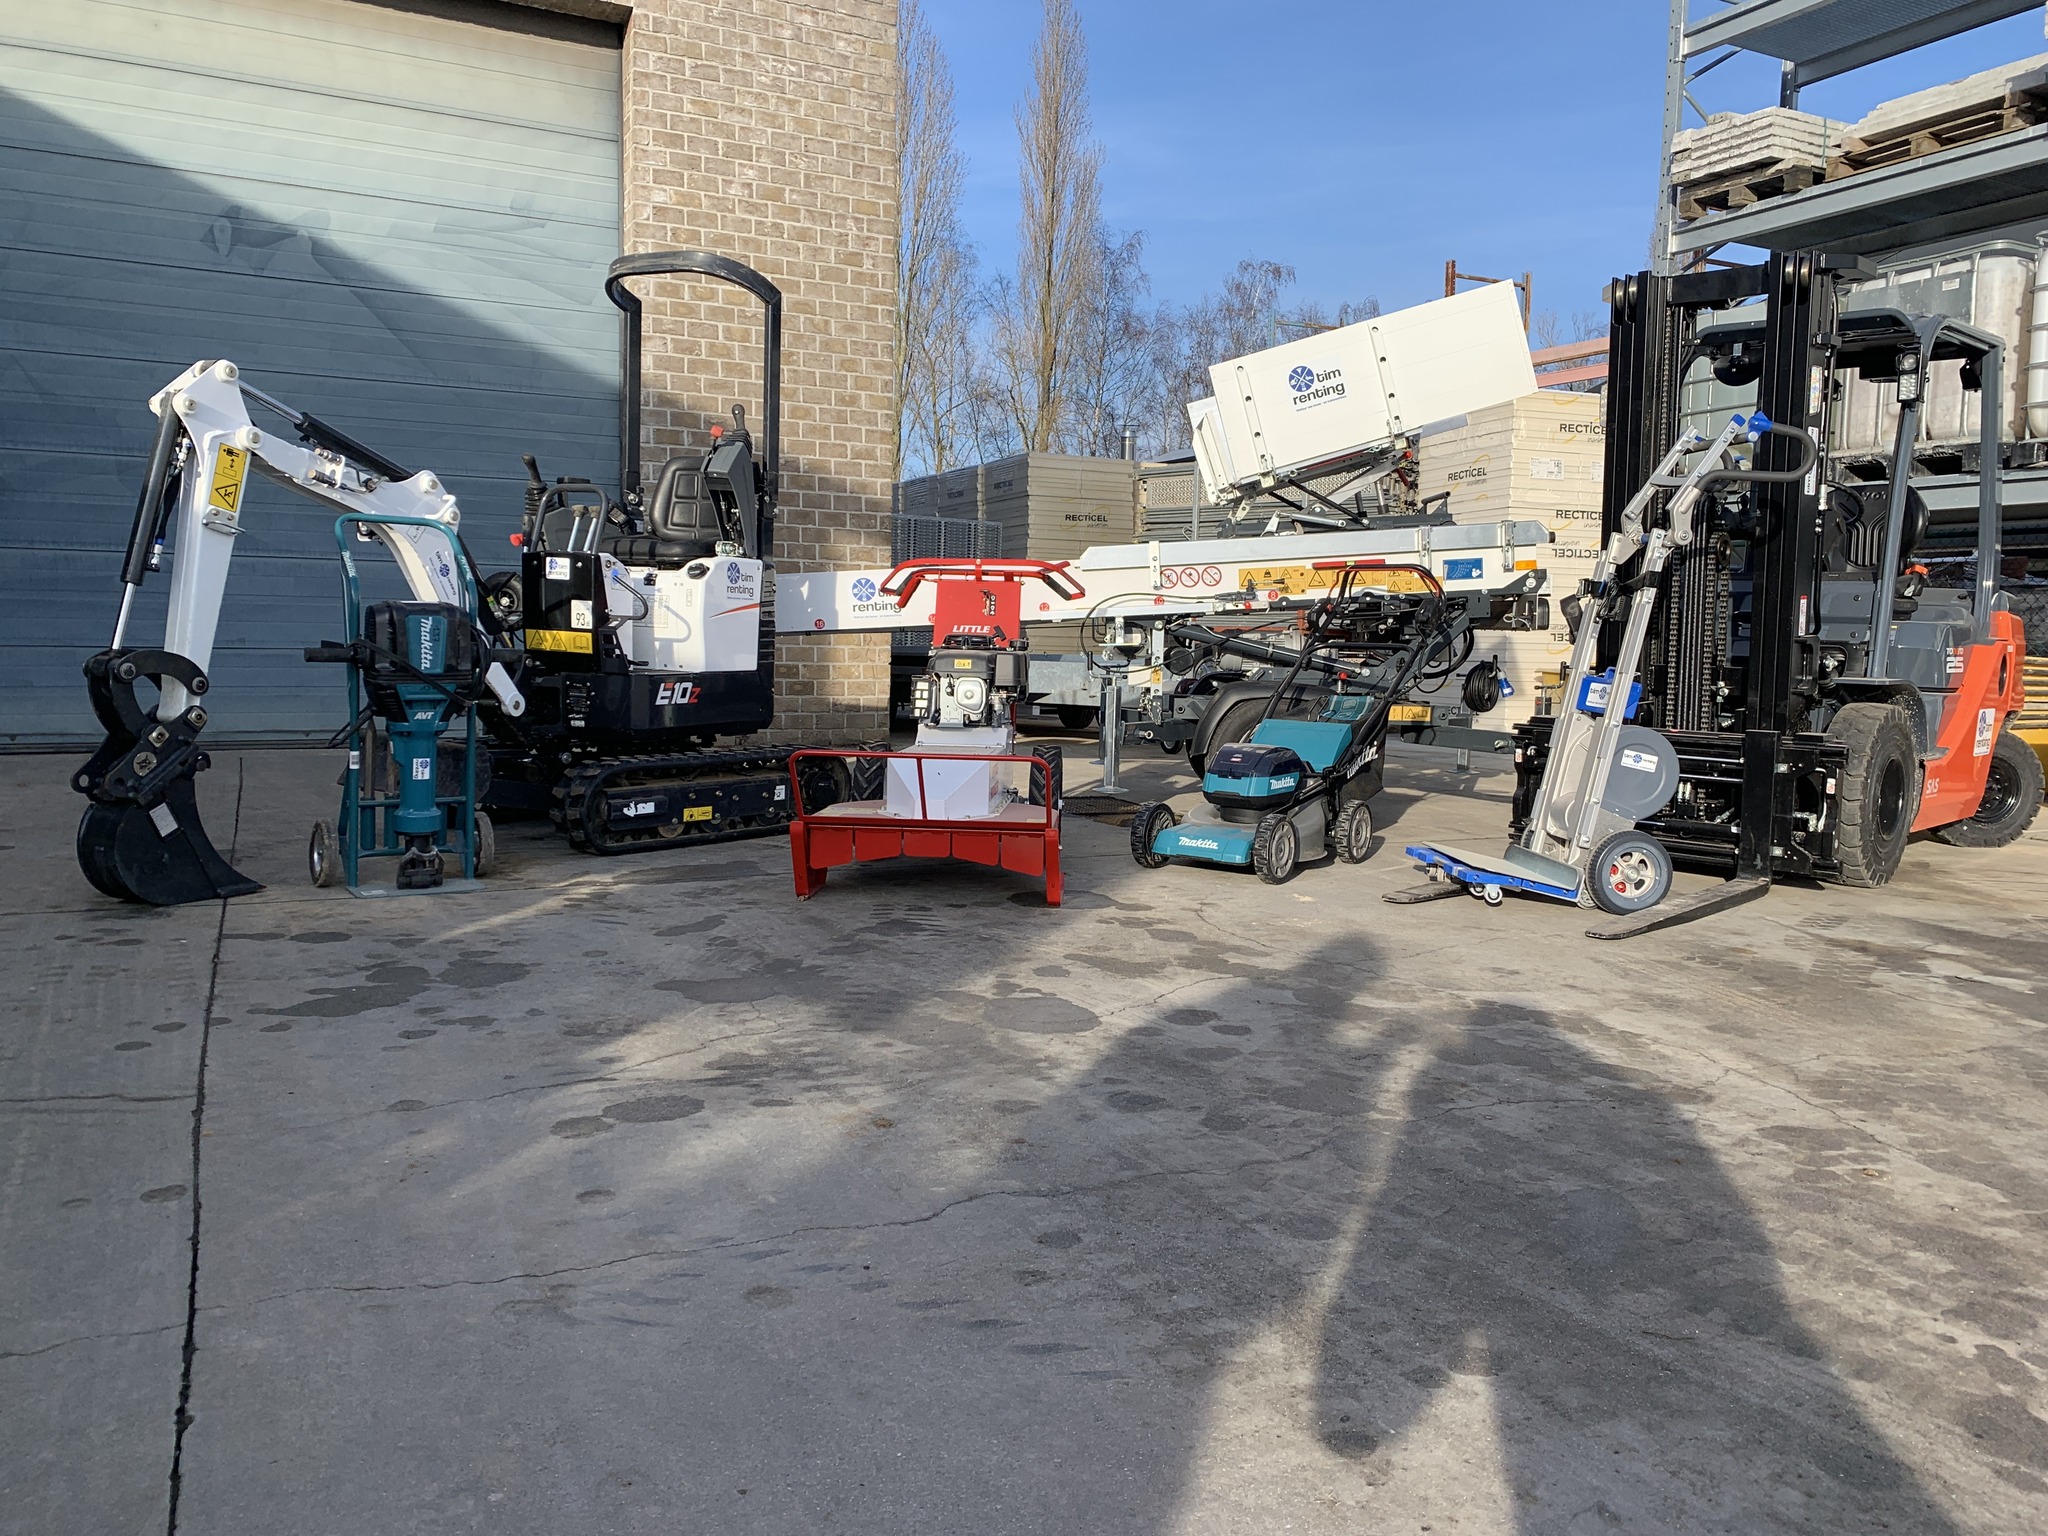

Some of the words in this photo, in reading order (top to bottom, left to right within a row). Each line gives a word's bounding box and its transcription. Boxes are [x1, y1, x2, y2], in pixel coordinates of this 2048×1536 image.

[1316, 368, 1341, 383] tim
[1292, 382, 1345, 405] renting
[1560, 421, 1606, 435] RECTICE
[1555, 510, 1602, 521] RECTICE
[1551, 549, 1599, 558] ECTICEL
[740, 573, 754, 583] tim
[726, 584, 754, 598] renting
[1270, 590, 1276, 599] 8
[852, 600, 902, 613] renting
[1040, 603, 1050, 612] 12
[575, 612, 586, 627] 93
[815, 620, 825, 629] 16
[952, 625, 991, 634] LITTLE
[420, 616, 433, 670] Makita
[1946, 656, 1964, 674] 25
[413, 711, 434, 720] AVT
[1269, 776, 1296, 790] Makita
[1925, 777, 1940, 795] SAS
[1178, 836, 1219, 850] Makita
